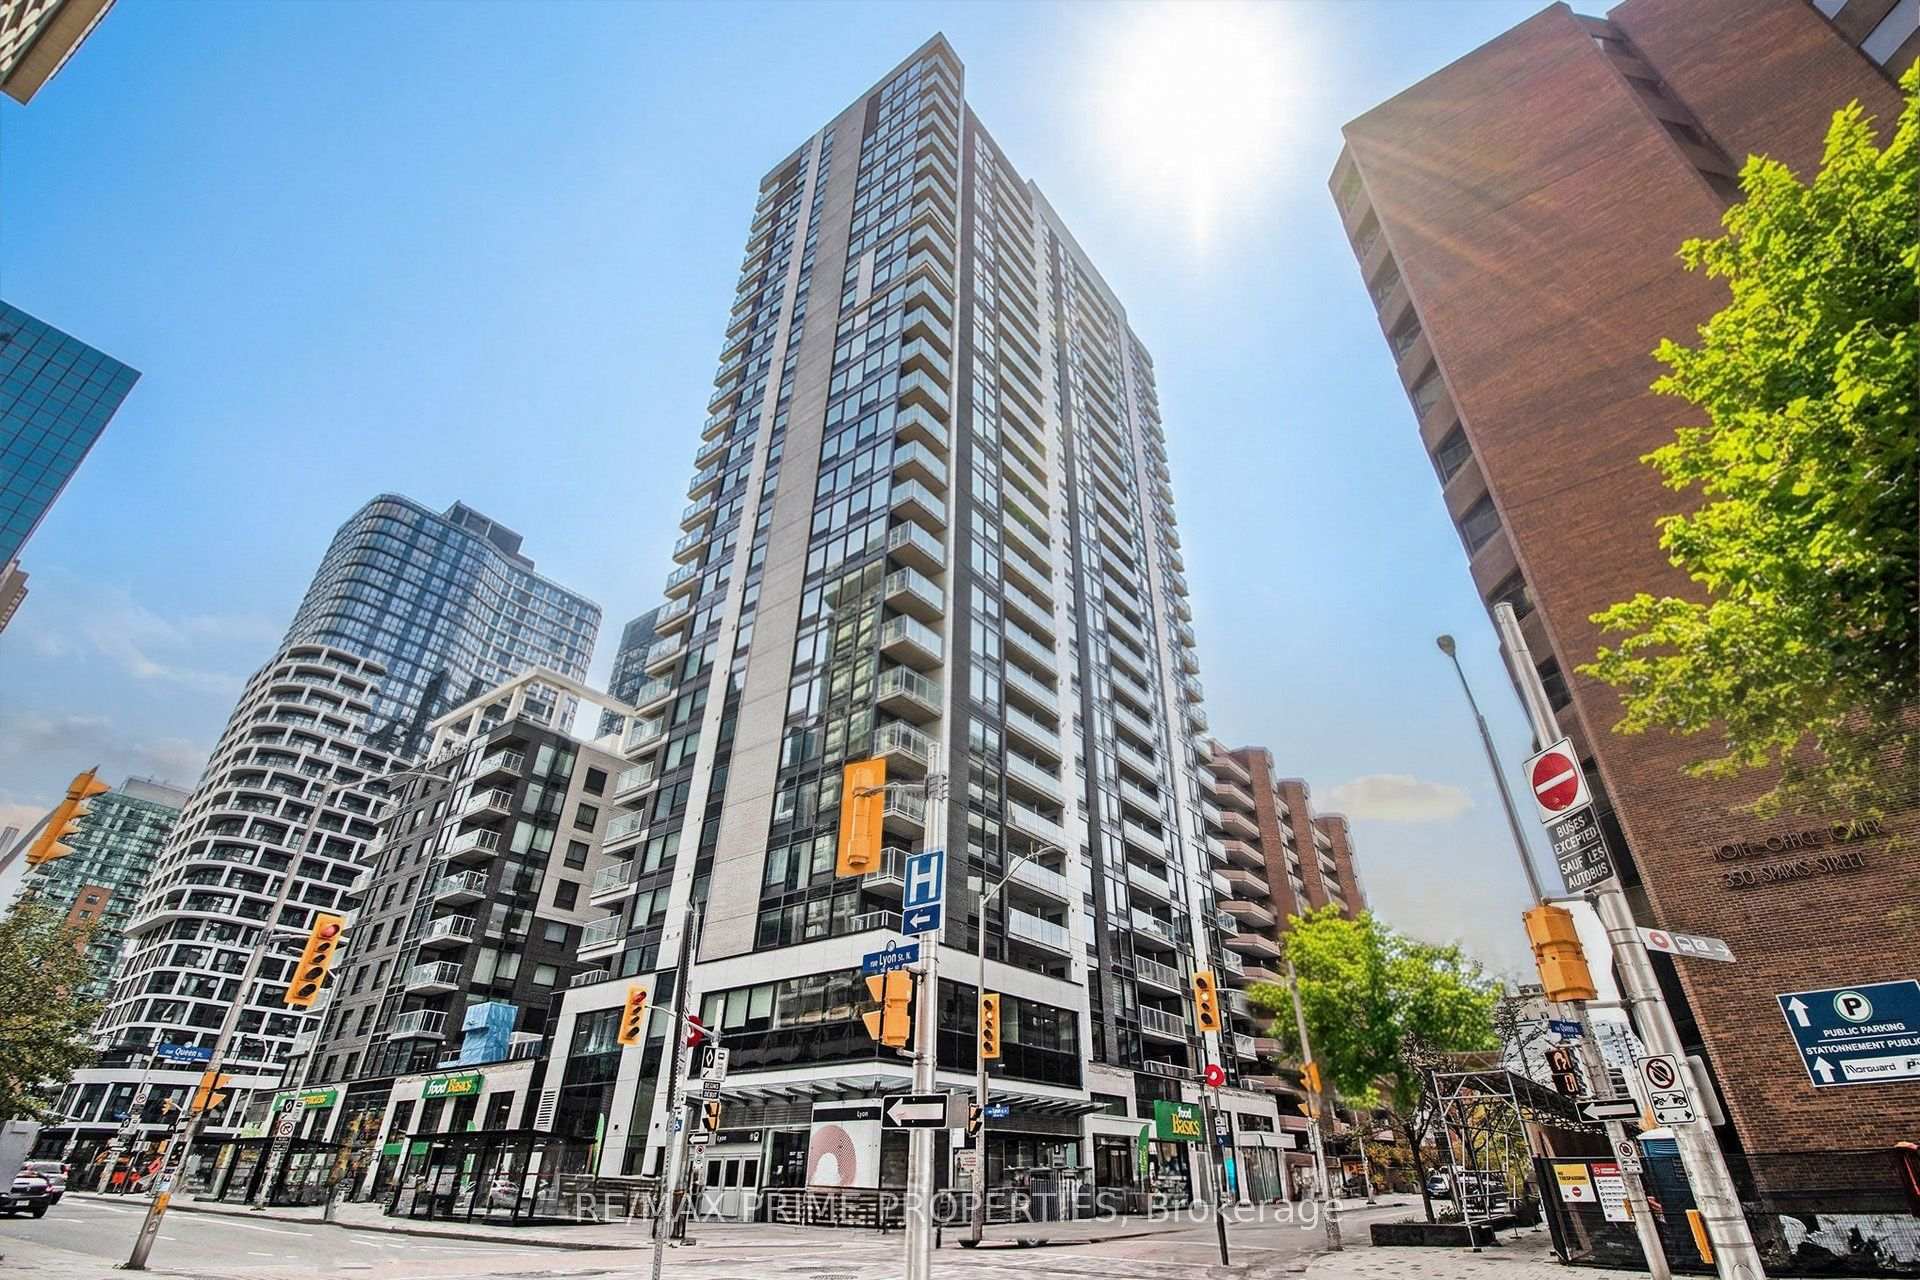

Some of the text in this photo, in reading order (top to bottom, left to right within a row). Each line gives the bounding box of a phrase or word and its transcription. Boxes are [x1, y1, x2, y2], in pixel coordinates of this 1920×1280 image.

[1556, 815, 1585, 838] BUSES
[1554, 827, 1597, 855] EXCEPTED
[1765, 829, 1819, 851] OFFICE
[1560, 846, 1605, 875] SAUF LES
[1760, 860, 1812, 882] SPARKS
[1815, 851, 1865, 873] STREET
[909, 855, 939, 904] H
[1568, 862, 1609, 889] AUTOBUS
[879, 953, 897, 968] Lyon
[1841, 997, 1862, 1016] P
[1823, 1022, 1906, 1038] PUBLIC PARKING
[1805, 1040, 1886, 1055] STATIONNEMENT
[427, 1080, 449, 1095] food
[856, 1111, 869, 1119] Lyon
[1177, 1106, 1192, 1119] food
[1172, 1112, 1200, 1136] Basics
